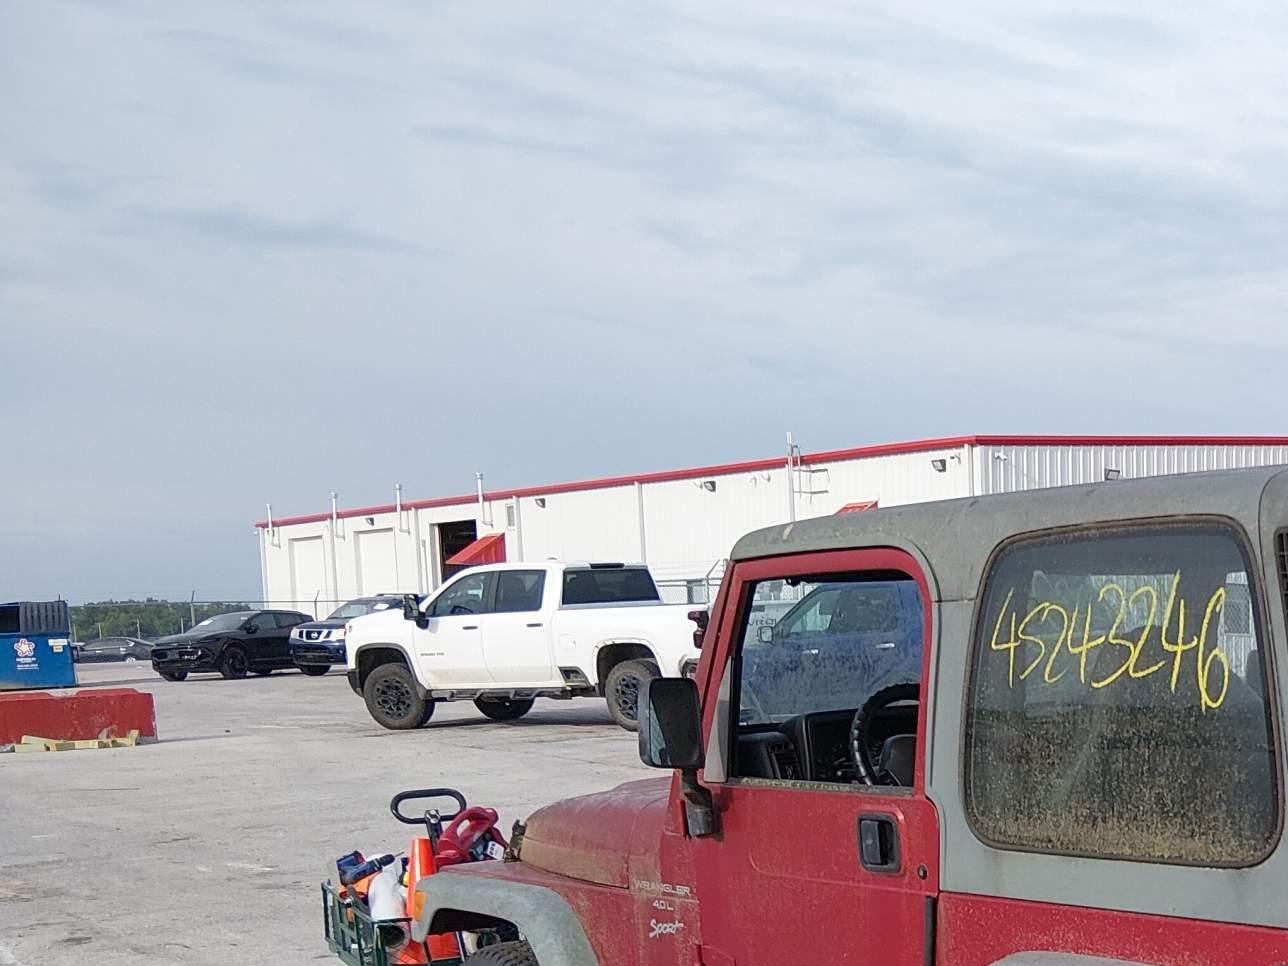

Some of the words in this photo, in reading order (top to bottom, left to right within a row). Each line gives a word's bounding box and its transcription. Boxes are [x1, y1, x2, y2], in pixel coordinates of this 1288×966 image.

[991, 568, 1230, 714] 45243246
[632, 878, 693, 897] WRANGLER
[648, 918, 685, 939] Sport
